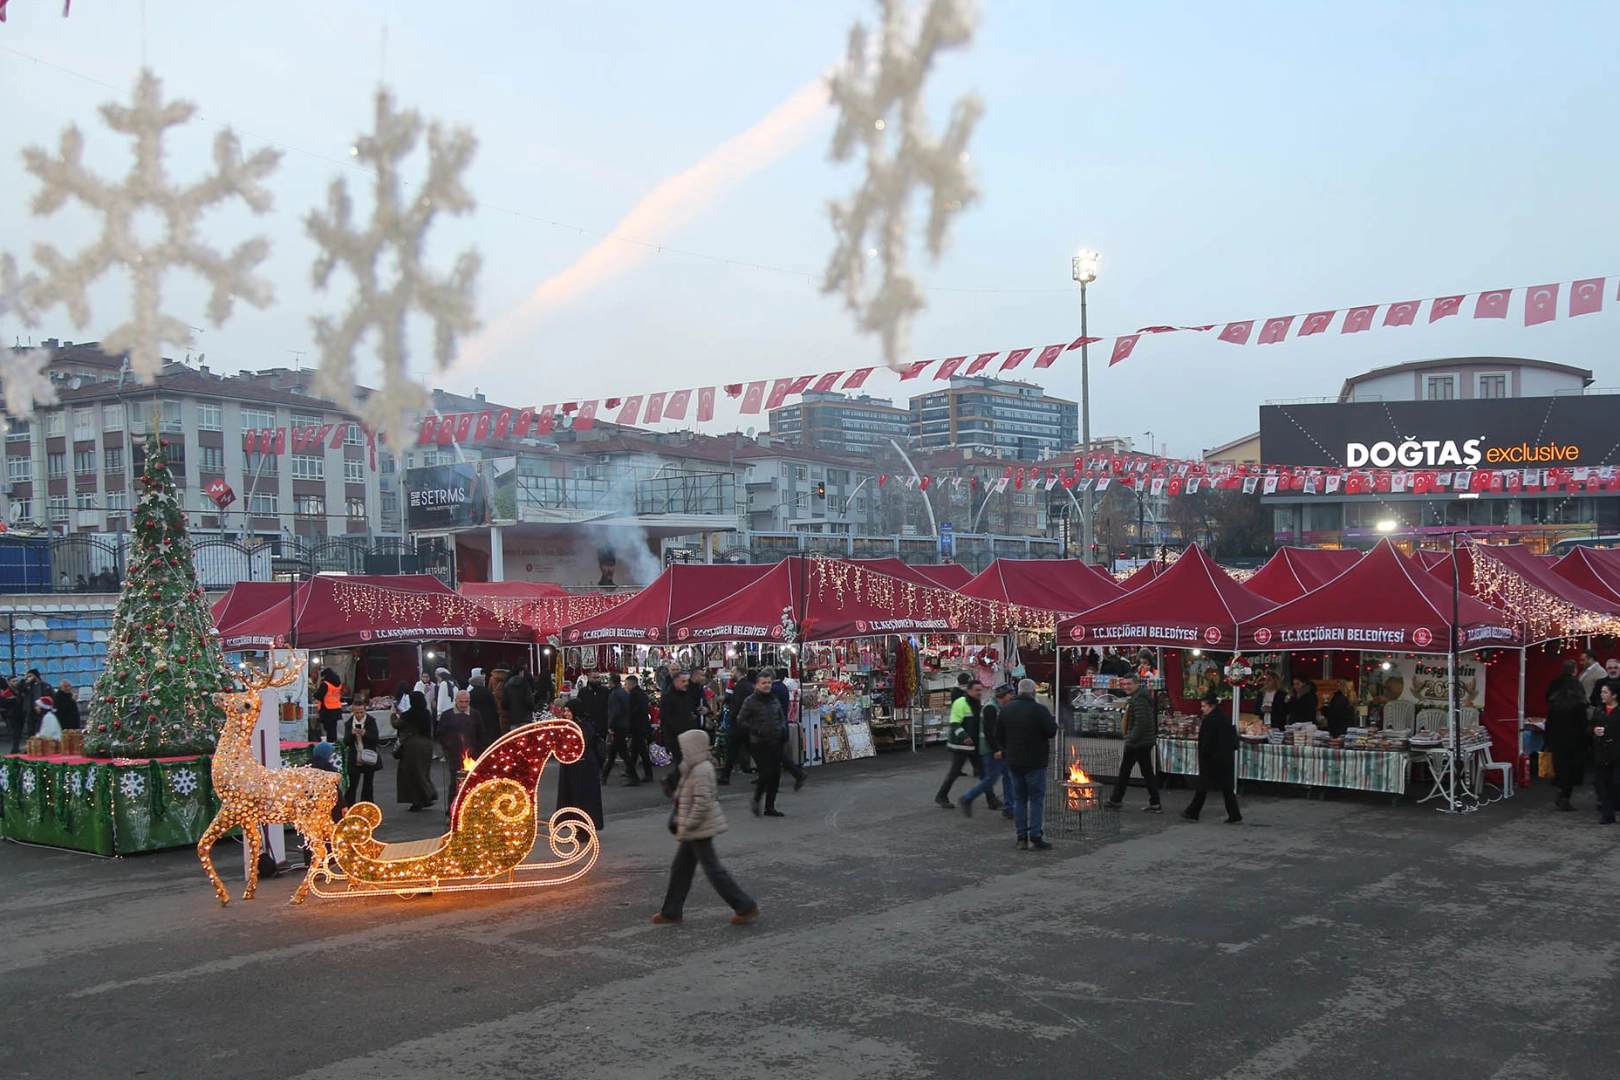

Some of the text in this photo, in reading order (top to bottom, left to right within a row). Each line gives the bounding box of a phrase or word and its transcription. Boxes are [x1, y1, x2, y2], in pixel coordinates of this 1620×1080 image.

[1347, 435, 1580, 471] DOĞTAŞ exclusive
[210, 483, 224, 492] M
[421, 487, 465, 505] SETRMS
[733, 625, 769, 637] BELEDİYESİ
[1149, 626, 1198, 641] BELEDİYESİ
[1347, 628, 1405, 643] BELEDİYESİ
